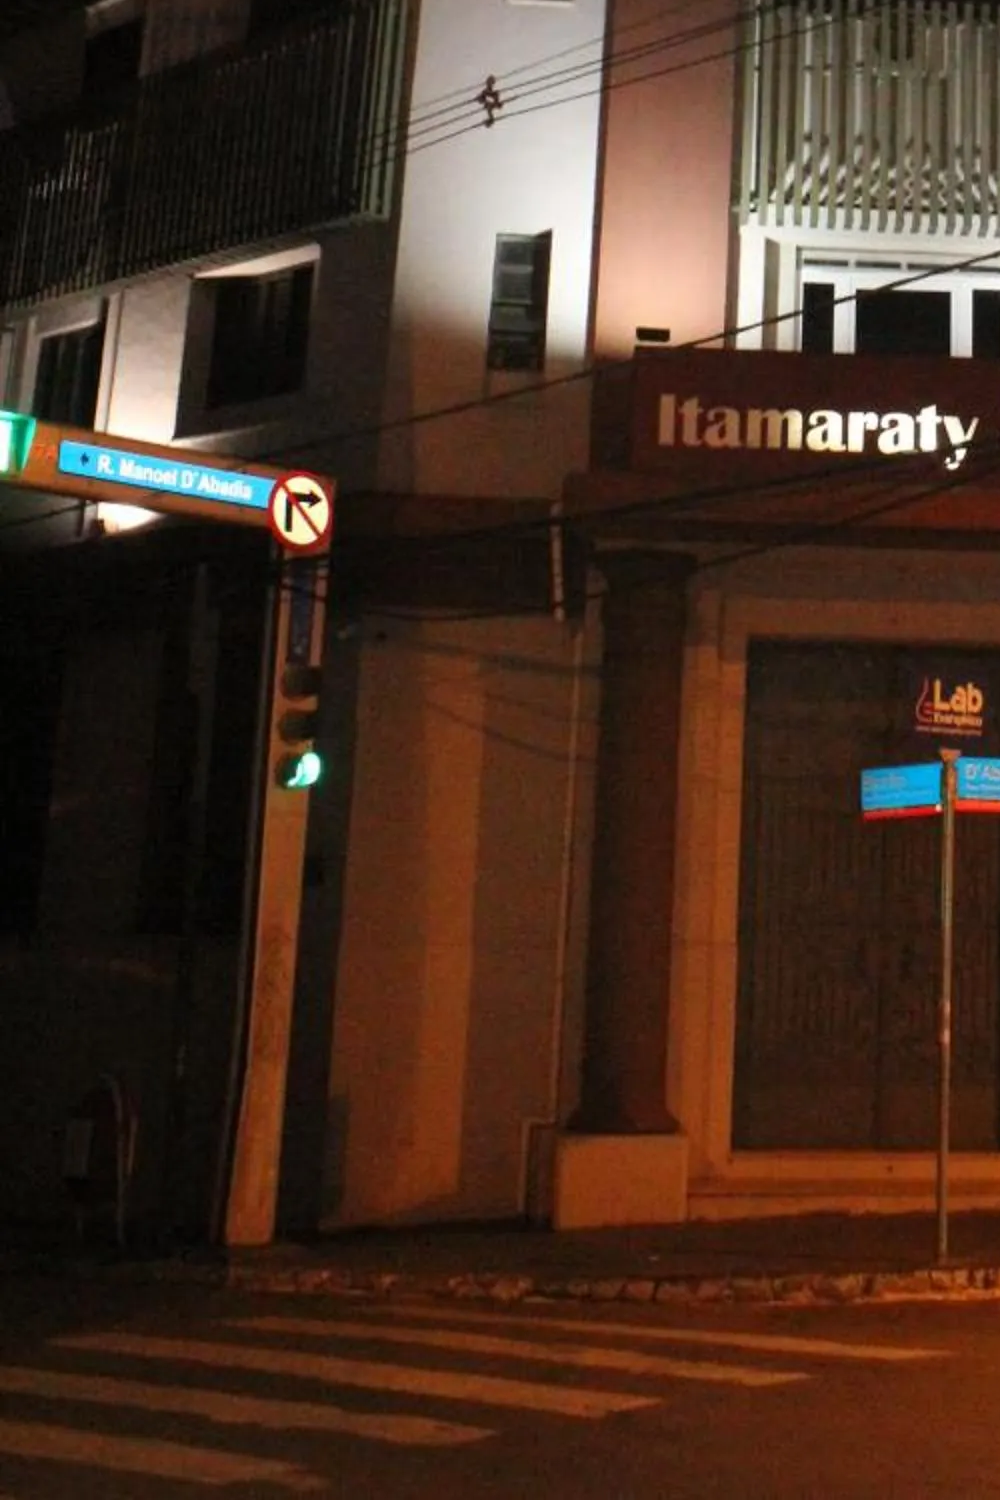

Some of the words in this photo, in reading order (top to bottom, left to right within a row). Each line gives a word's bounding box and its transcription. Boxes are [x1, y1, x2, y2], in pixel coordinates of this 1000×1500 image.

[658, 393, 979, 470] Itamaraty
[97, 454, 114, 476] R.
[119, 457, 178, 486] Manoel
[933, 678, 984, 714] Lab
